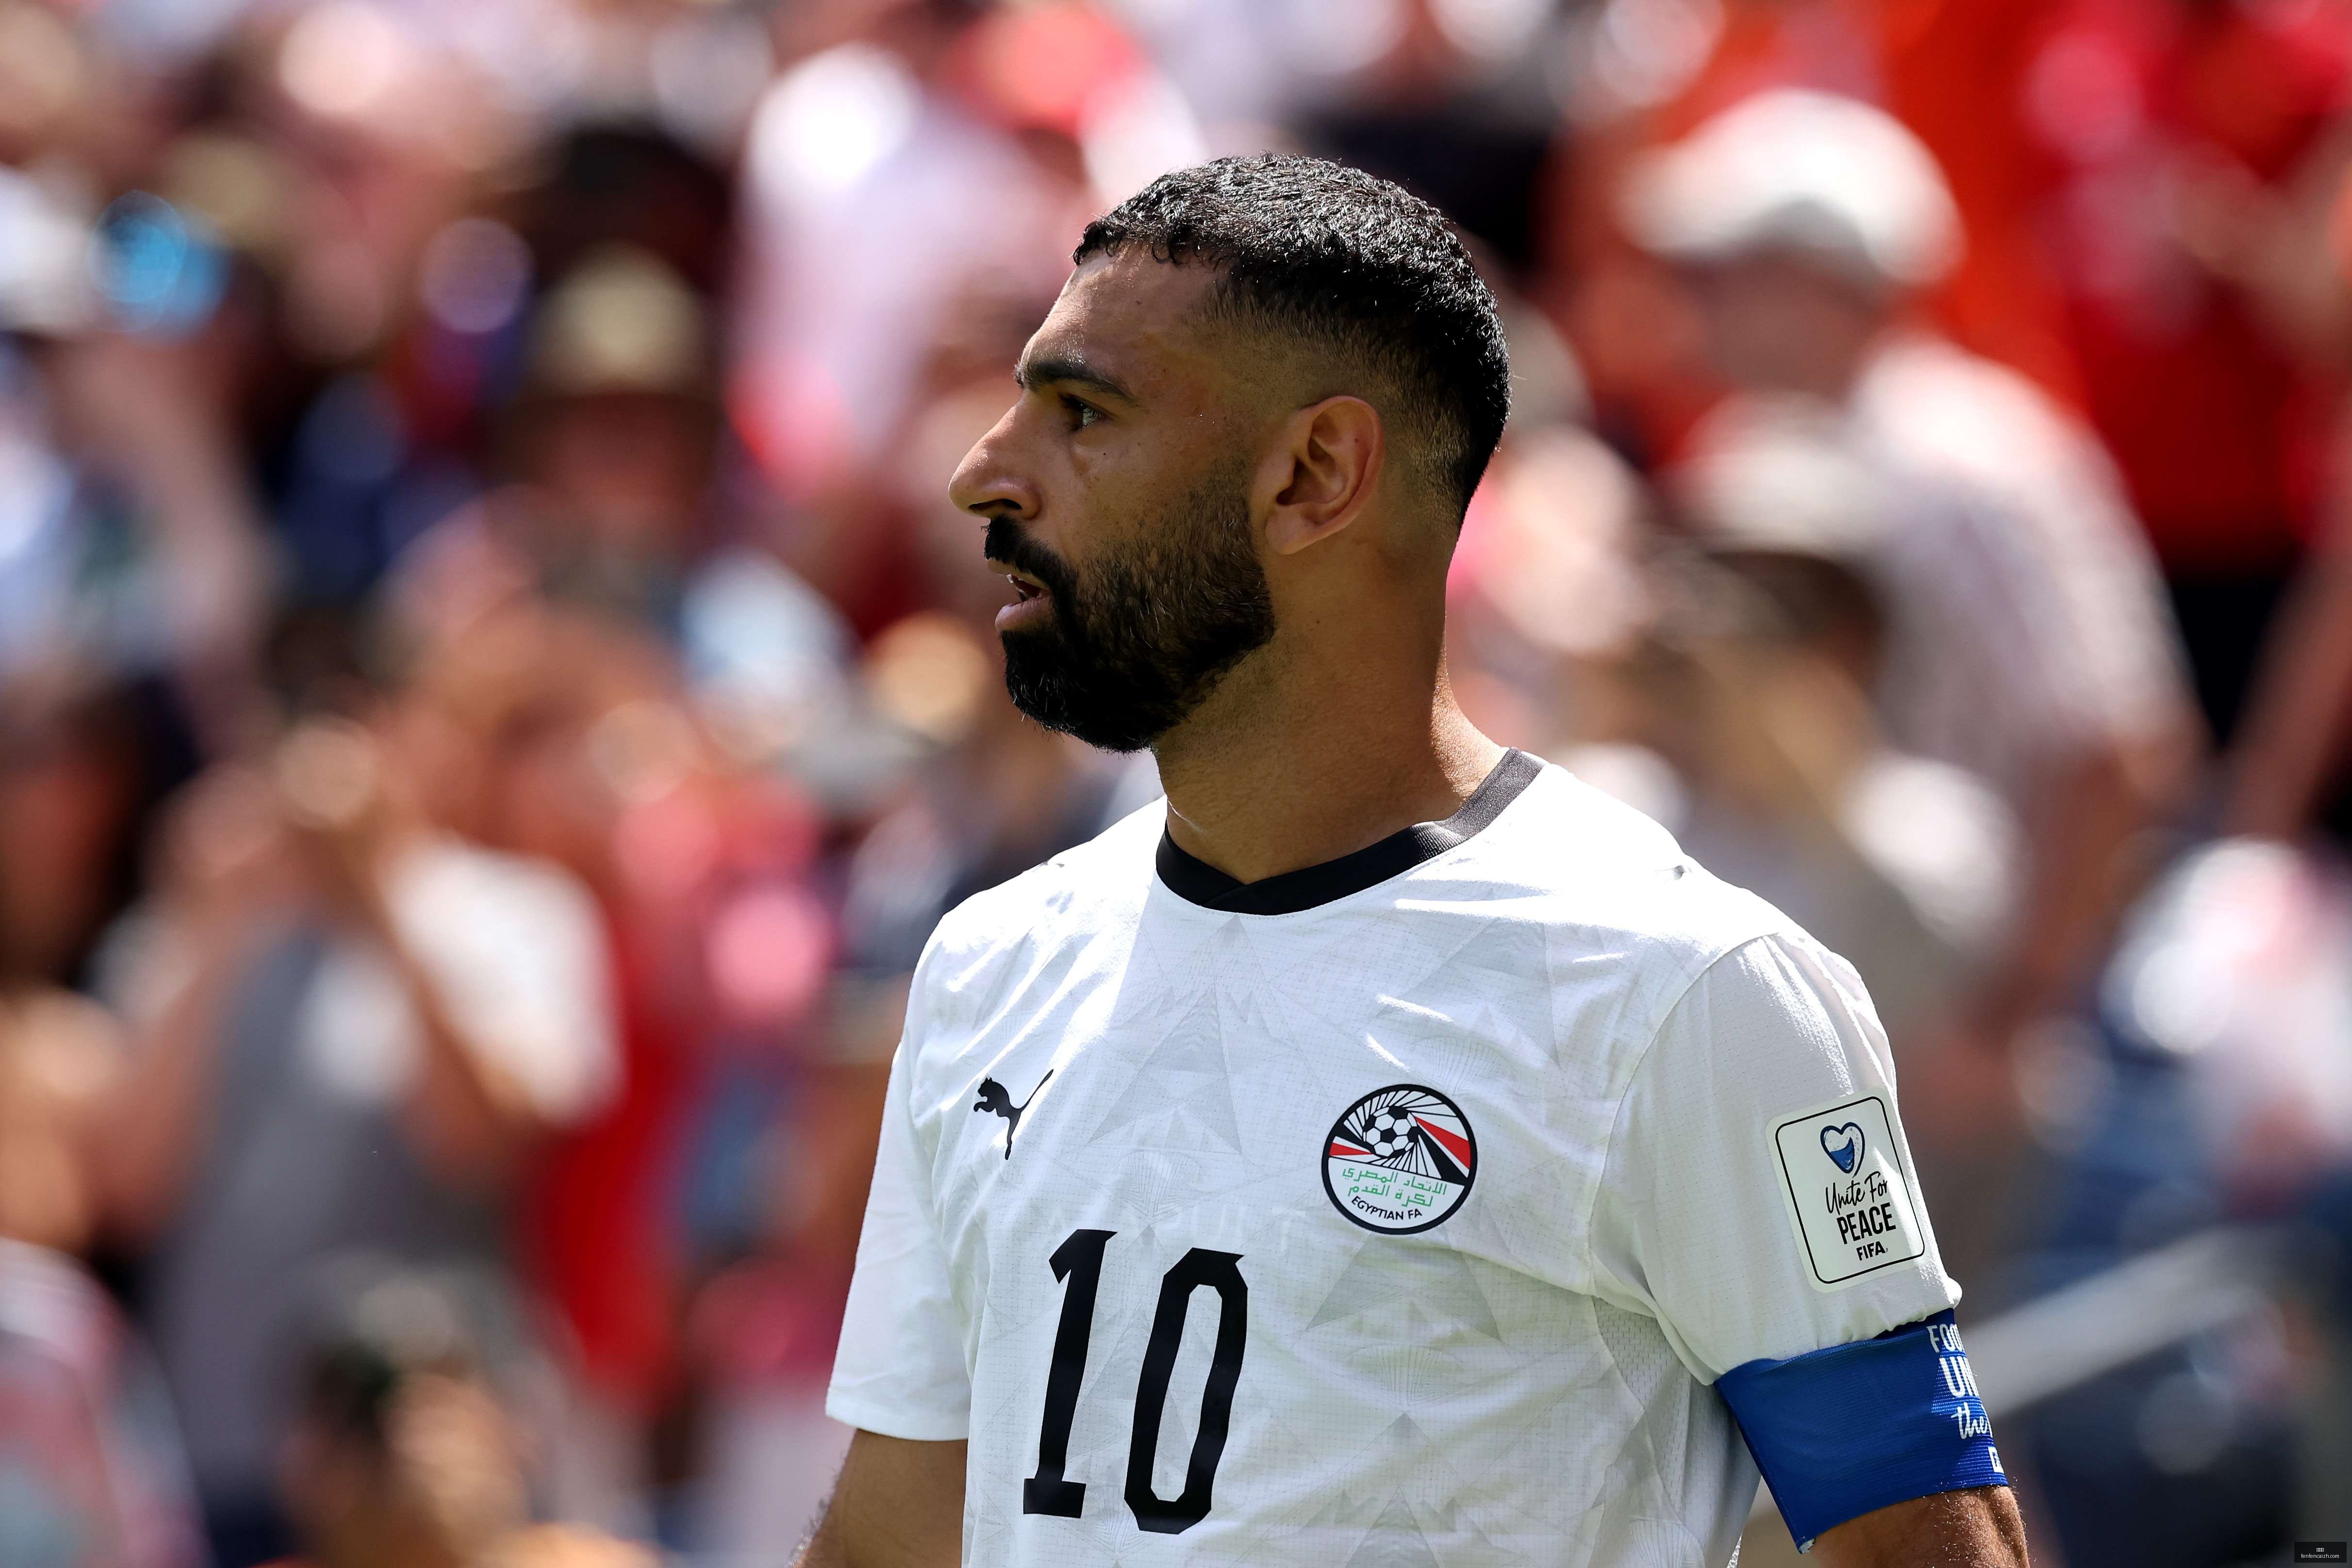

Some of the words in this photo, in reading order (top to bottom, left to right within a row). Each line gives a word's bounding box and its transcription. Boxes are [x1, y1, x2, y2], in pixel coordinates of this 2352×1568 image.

[1342, 1168, 1398, 1183] المصري
[1404, 1176, 1447, 1195] الاتحاد
[1348, 1184, 1390, 1196] القدم
[1395, 1189, 1433, 1207] لكرة
[1826, 1180, 1865, 1215] Unite
[1864, 1171, 1887, 1203] For
[1351, 1196, 1404, 1220] EGYPTIAN
[1408, 1208, 1422, 1219] FA
[1836, 1202, 1896, 1244] PEACE
[1856, 1241, 1886, 1261] FIFA
[1926, 1323, 1965, 1353] FOO
[1023, 1229, 1248, 1535] 10
